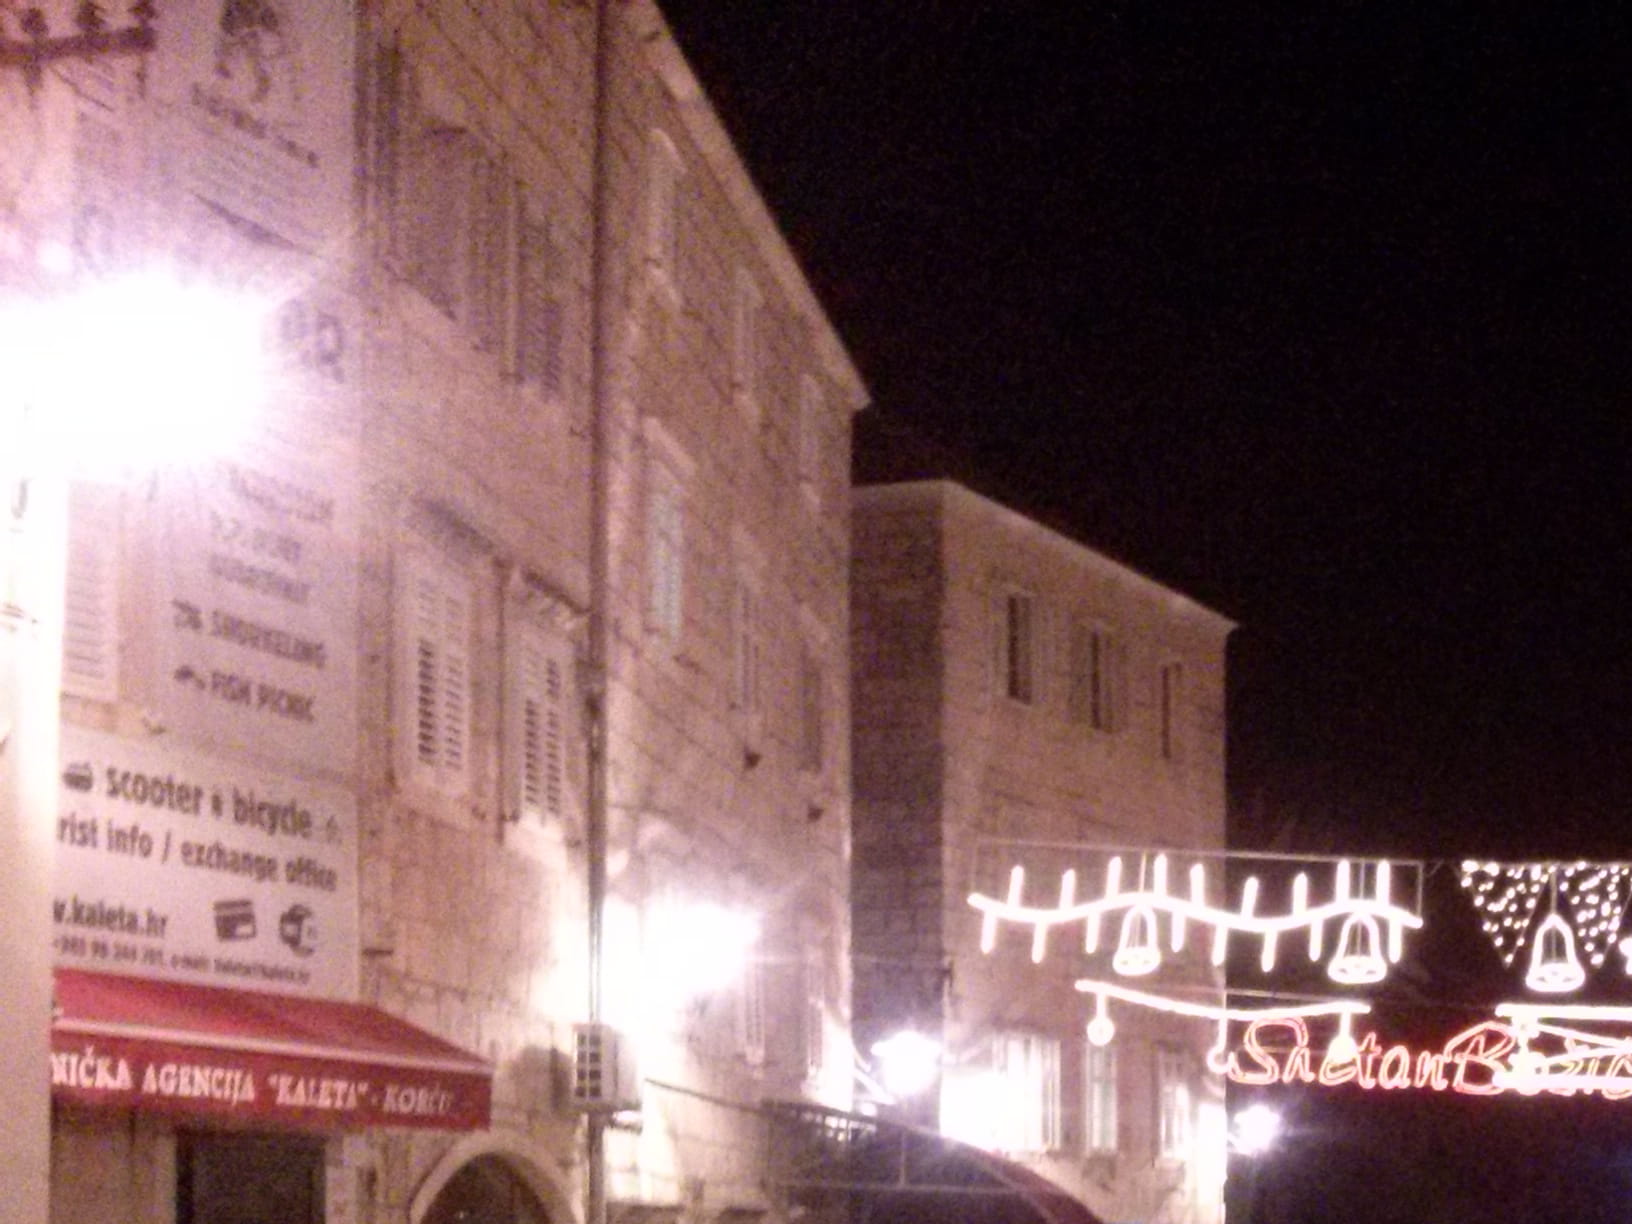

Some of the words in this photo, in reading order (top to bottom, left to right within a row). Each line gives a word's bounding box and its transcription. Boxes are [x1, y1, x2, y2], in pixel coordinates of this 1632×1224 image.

[106, 767, 203, 816] scooter
[107, 818, 153, 859] info
[181, 841, 278, 884] exchange
[142, 1063, 255, 1106] AGENCIJA
